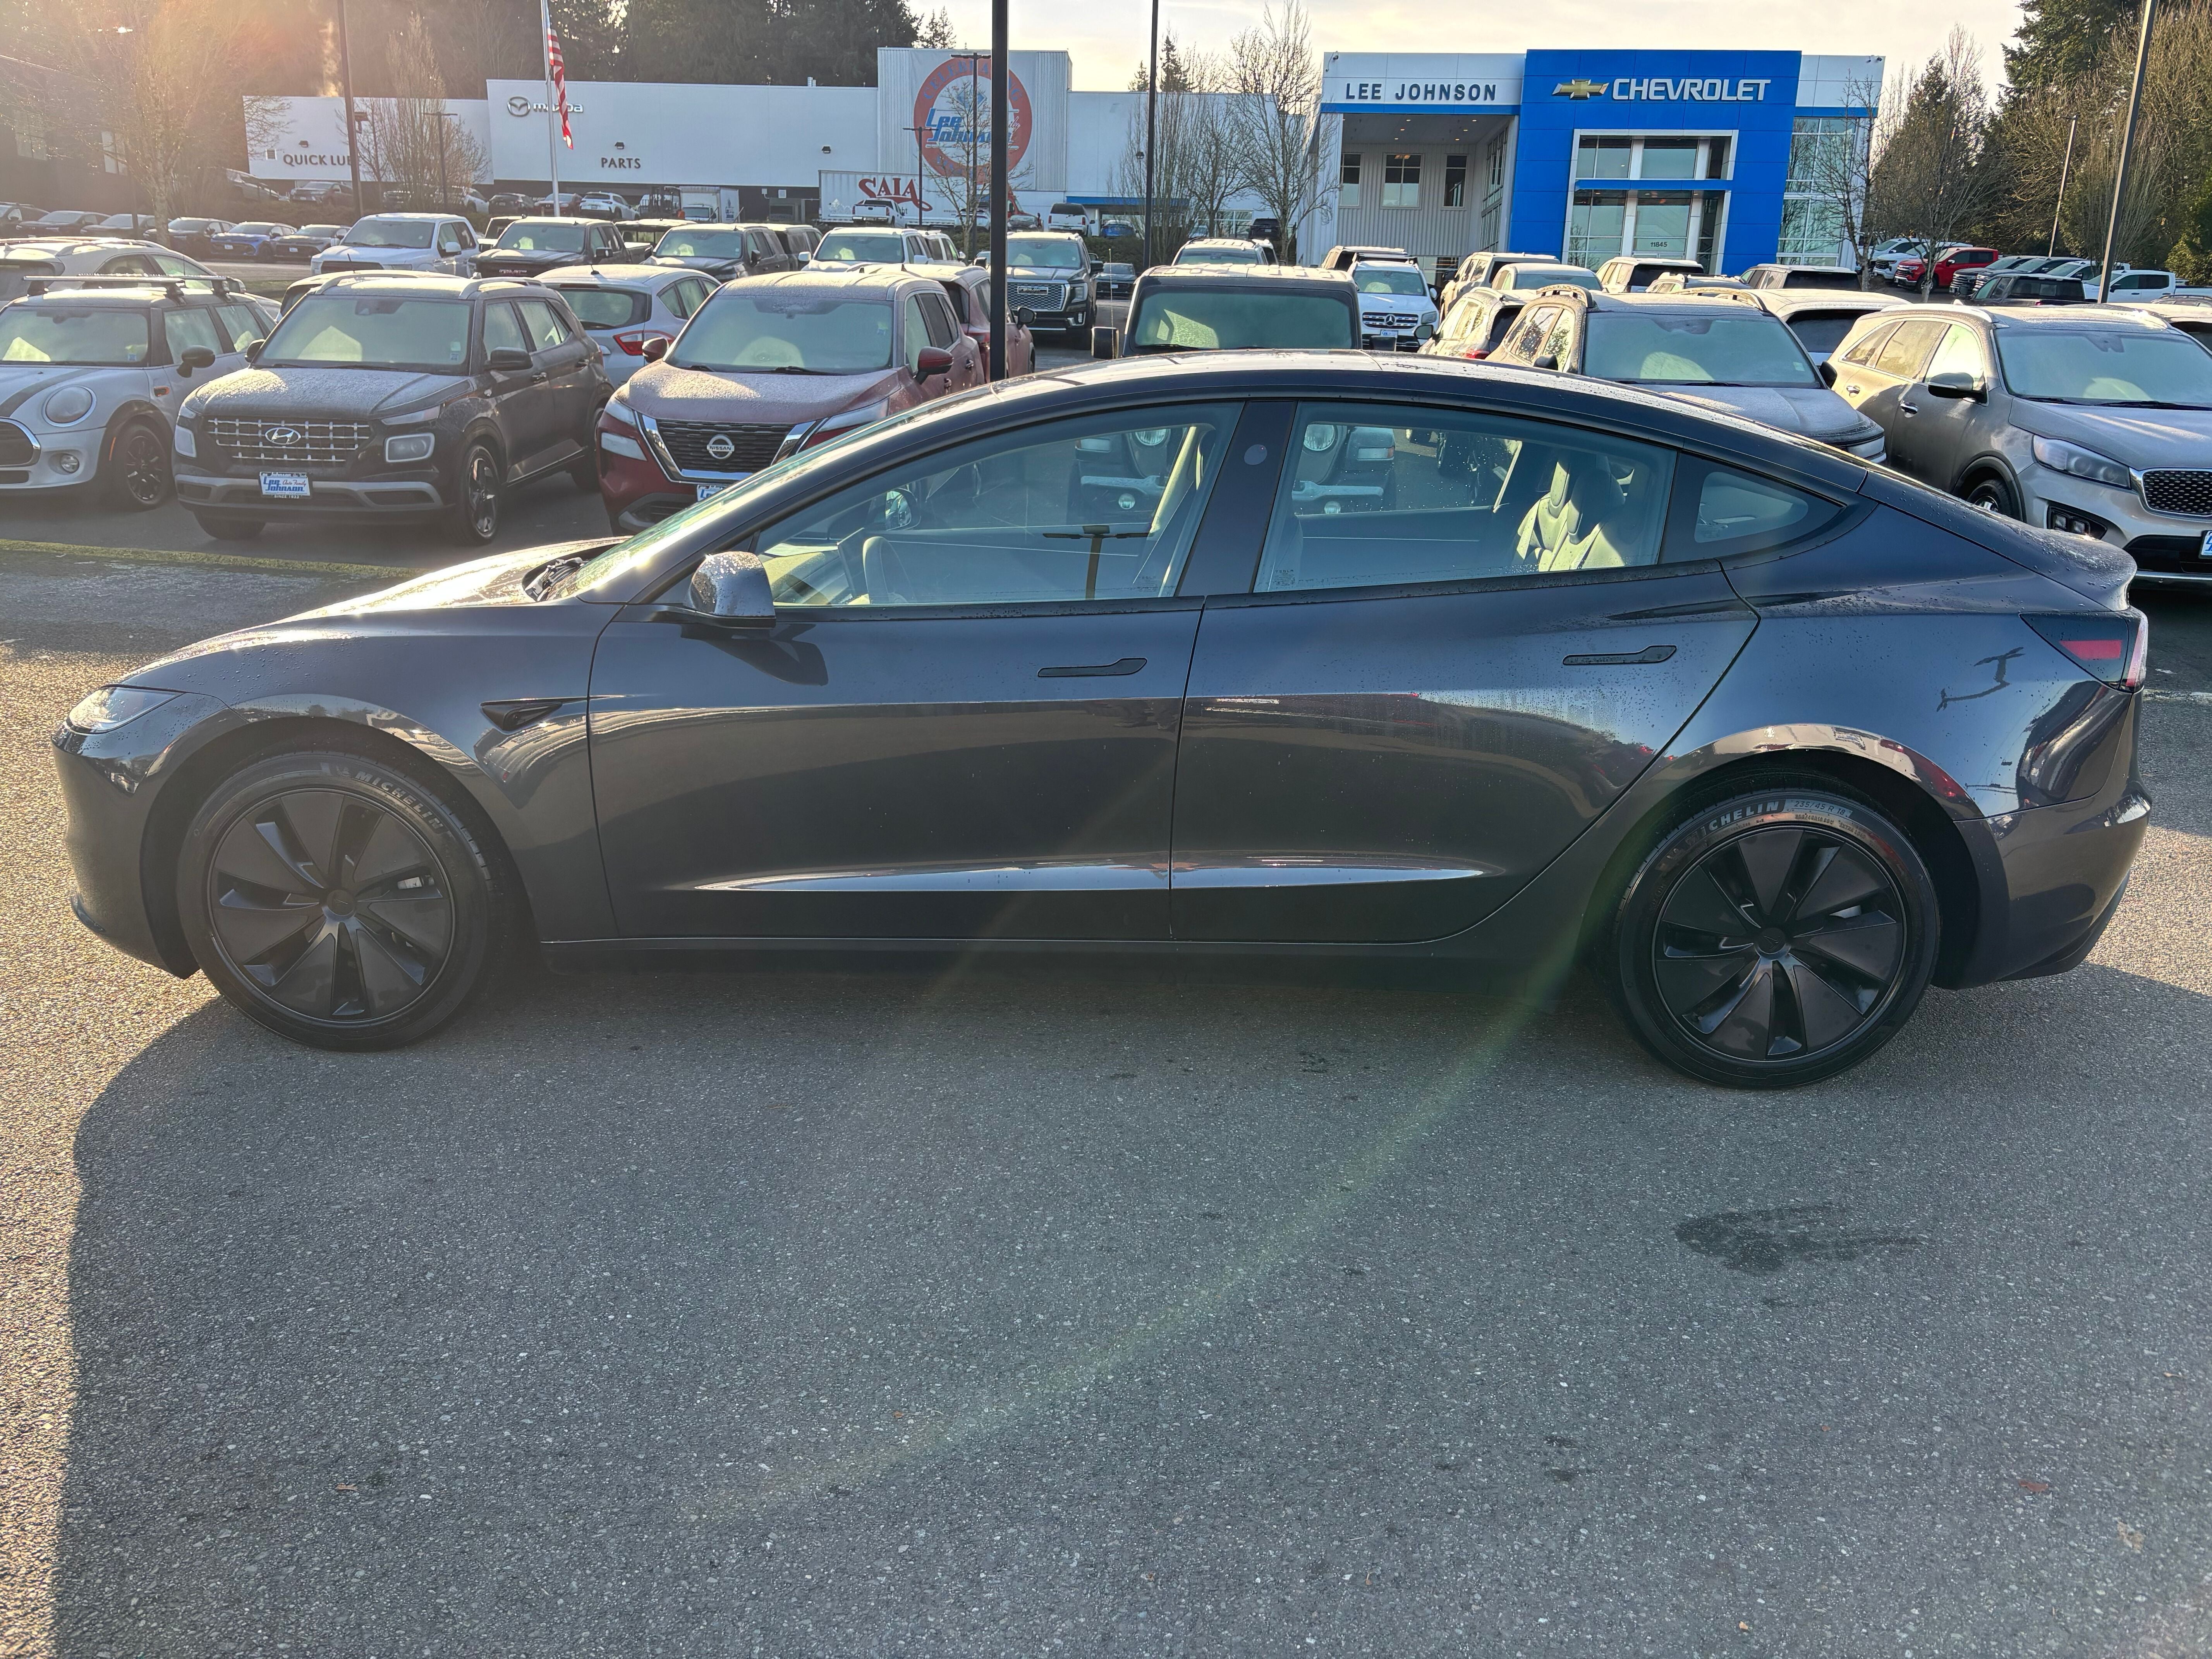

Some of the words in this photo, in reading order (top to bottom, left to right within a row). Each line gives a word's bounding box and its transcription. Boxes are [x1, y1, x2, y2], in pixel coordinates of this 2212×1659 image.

[1346, 83, 1382, 100] LEE
[1395, 84, 1496, 101] JOHNSON
[1613, 78, 1771, 101] CHEVROLET
[926, 108, 962, 127] Lee
[283, 154, 327, 167] QUICK
[601, 157, 641, 169] PARTS
[859, 177, 933, 208] SAIA
[355, 771, 443, 829] MICHELIN
[1685, 801, 1779, 846] MICHELIN
[1794, 801, 1826, 810] 235/45
